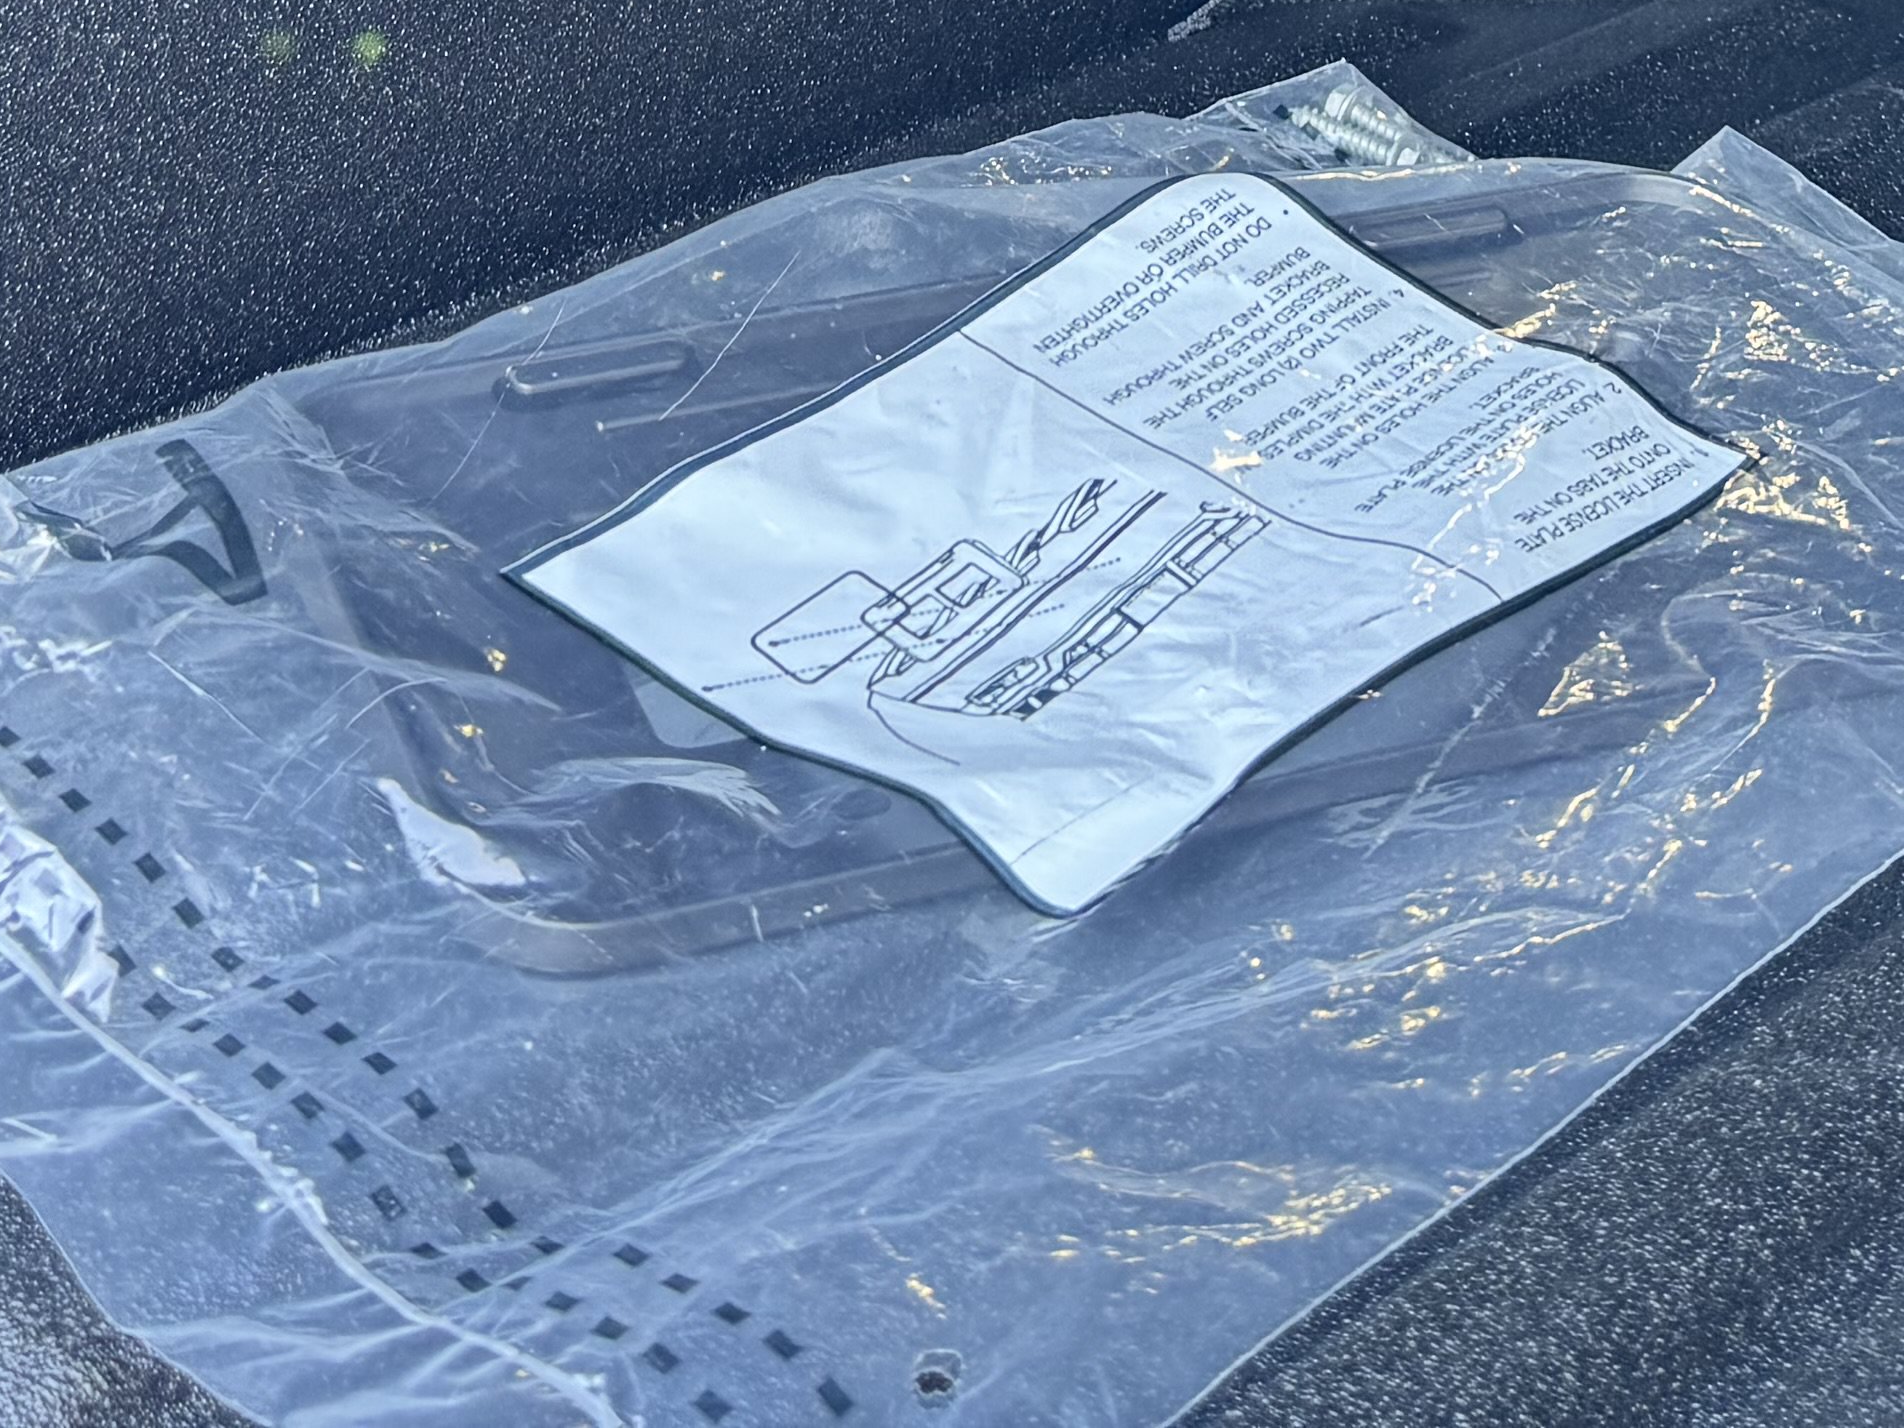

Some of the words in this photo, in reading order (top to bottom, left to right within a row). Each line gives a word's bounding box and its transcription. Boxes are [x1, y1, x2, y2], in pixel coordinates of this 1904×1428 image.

[1200, 188, 1236, 215] THE
[1218, 202, 1255, 229] THE
[1135, 207, 1205, 254] SCREWS.
[1245, 216, 1272, 238] DO
[1159, 222, 1224, 267] BUMPER
[1215, 233, 1249, 261] NOT
[1135, 263, 1164, 286] OR
[1171, 254, 1219, 284] DRILL
[1244, 246, 1311, 287] BUMPER.
[1263, 260, 1331, 307] BRACKET
[1122, 281, 1178, 322] HOLES
[1273, 272, 1351, 325] RECESSED
[1309, 286, 1372, 326] TAPPING
[1032, 282, 1140, 354] OVERTIGHTEN
[1231, 300, 1265, 328] AND
[1331, 297, 1391, 333] INSTALL
[1048, 319, 1129, 368] THROUGH
[1178, 324, 1235, 364] SCREW
[1224, 321, 1279, 358] HOLES
[1247, 322, 1314, 368] SCREWS
[1299, 332, 1340, 360] TWO
[1398, 324, 1434, 347] THE
[1200, 354, 1229, 373] ON
[1277, 355, 1303, 371] (2)
[1354, 341, 1404, 378] FRONT
[1387, 335, 1454, 382] BRACKET
[1102, 360, 1183, 406] THROUGH
[1168, 369, 1207, 391] THE
[1175, 365, 1254, 412] THROUGH
[1238, 368, 1285, 397] LONG
[1334, 373, 1356, 392] OF
[1348, 377, 1392, 405] WITH
[1421, 383, 1457, 403] THE
[1511, 371, 1564, 401] HOLES
[1205, 393, 1243, 422] SELF
[1299, 388, 1337, 411] THE
[1318, 401, 1356, 423] THE
[1488, 401, 1517, 418] ON
[1521, 378, 1586, 418] LICENSE
[1559, 389, 1605, 418] ALIGN
[1142, 407, 1182, 430] THE
[1374, 400, 1428, 435] HOLES
[1458, 417, 1496, 436] THE
[1478, 413, 1529, 444] PLATE
[1350, 433, 1379, 451] ON
[1442, 442, 1488, 467] WITH
[1581, 424, 1650, 461] BRACKET.
[1319, 448, 1358, 469] THE
[1397, 436, 1466, 478] LICENSE
[1628, 443, 1671, 472] ONTO
[1411, 468, 1451, 489] THE
[1566, 472, 1609, 497] TABS
[1600, 460, 1635, 484] THE
[1641, 456, 1696, 492] INSERT
[1354, 479, 1407, 513] PLATE
[1543, 492, 1573, 509] ON
[1613, 482, 1649, 506] THE
[1513, 505, 1553, 525] THE
[1558, 495, 1621, 533] LICENSE
[1514, 522, 1565, 553] PLATE
